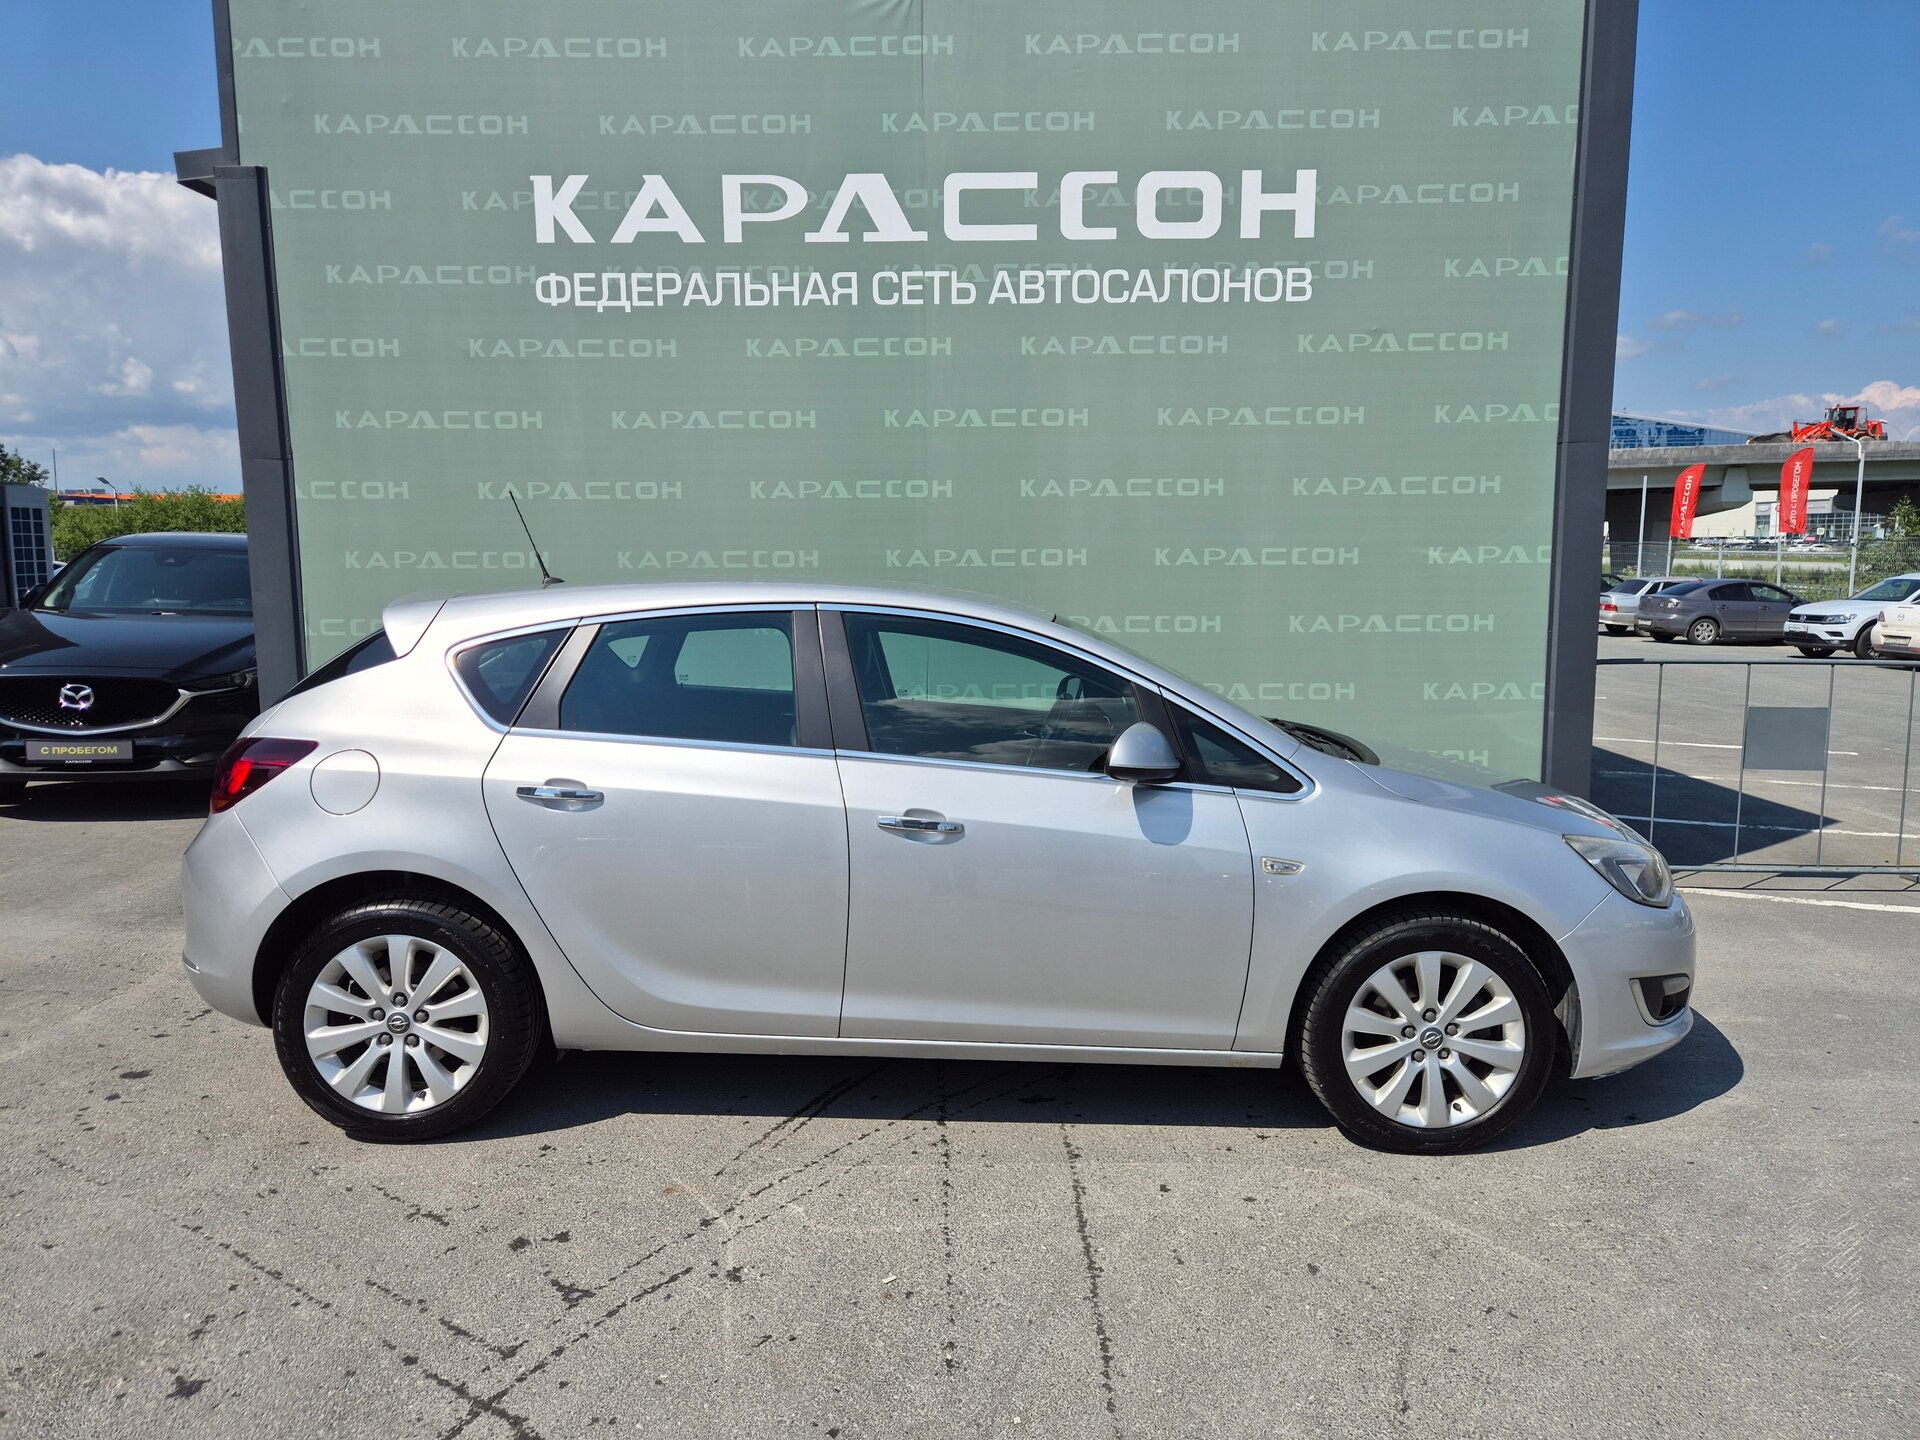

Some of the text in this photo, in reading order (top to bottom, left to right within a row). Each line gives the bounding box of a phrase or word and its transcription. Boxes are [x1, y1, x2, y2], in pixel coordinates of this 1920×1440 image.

[535, 267, 1313, 313] ФЕДЕРАЛЬНАЯ СЕТЬ АВТОСАЛОНОВ
[52, 746, 118, 755] ПРОБЕГОМ
